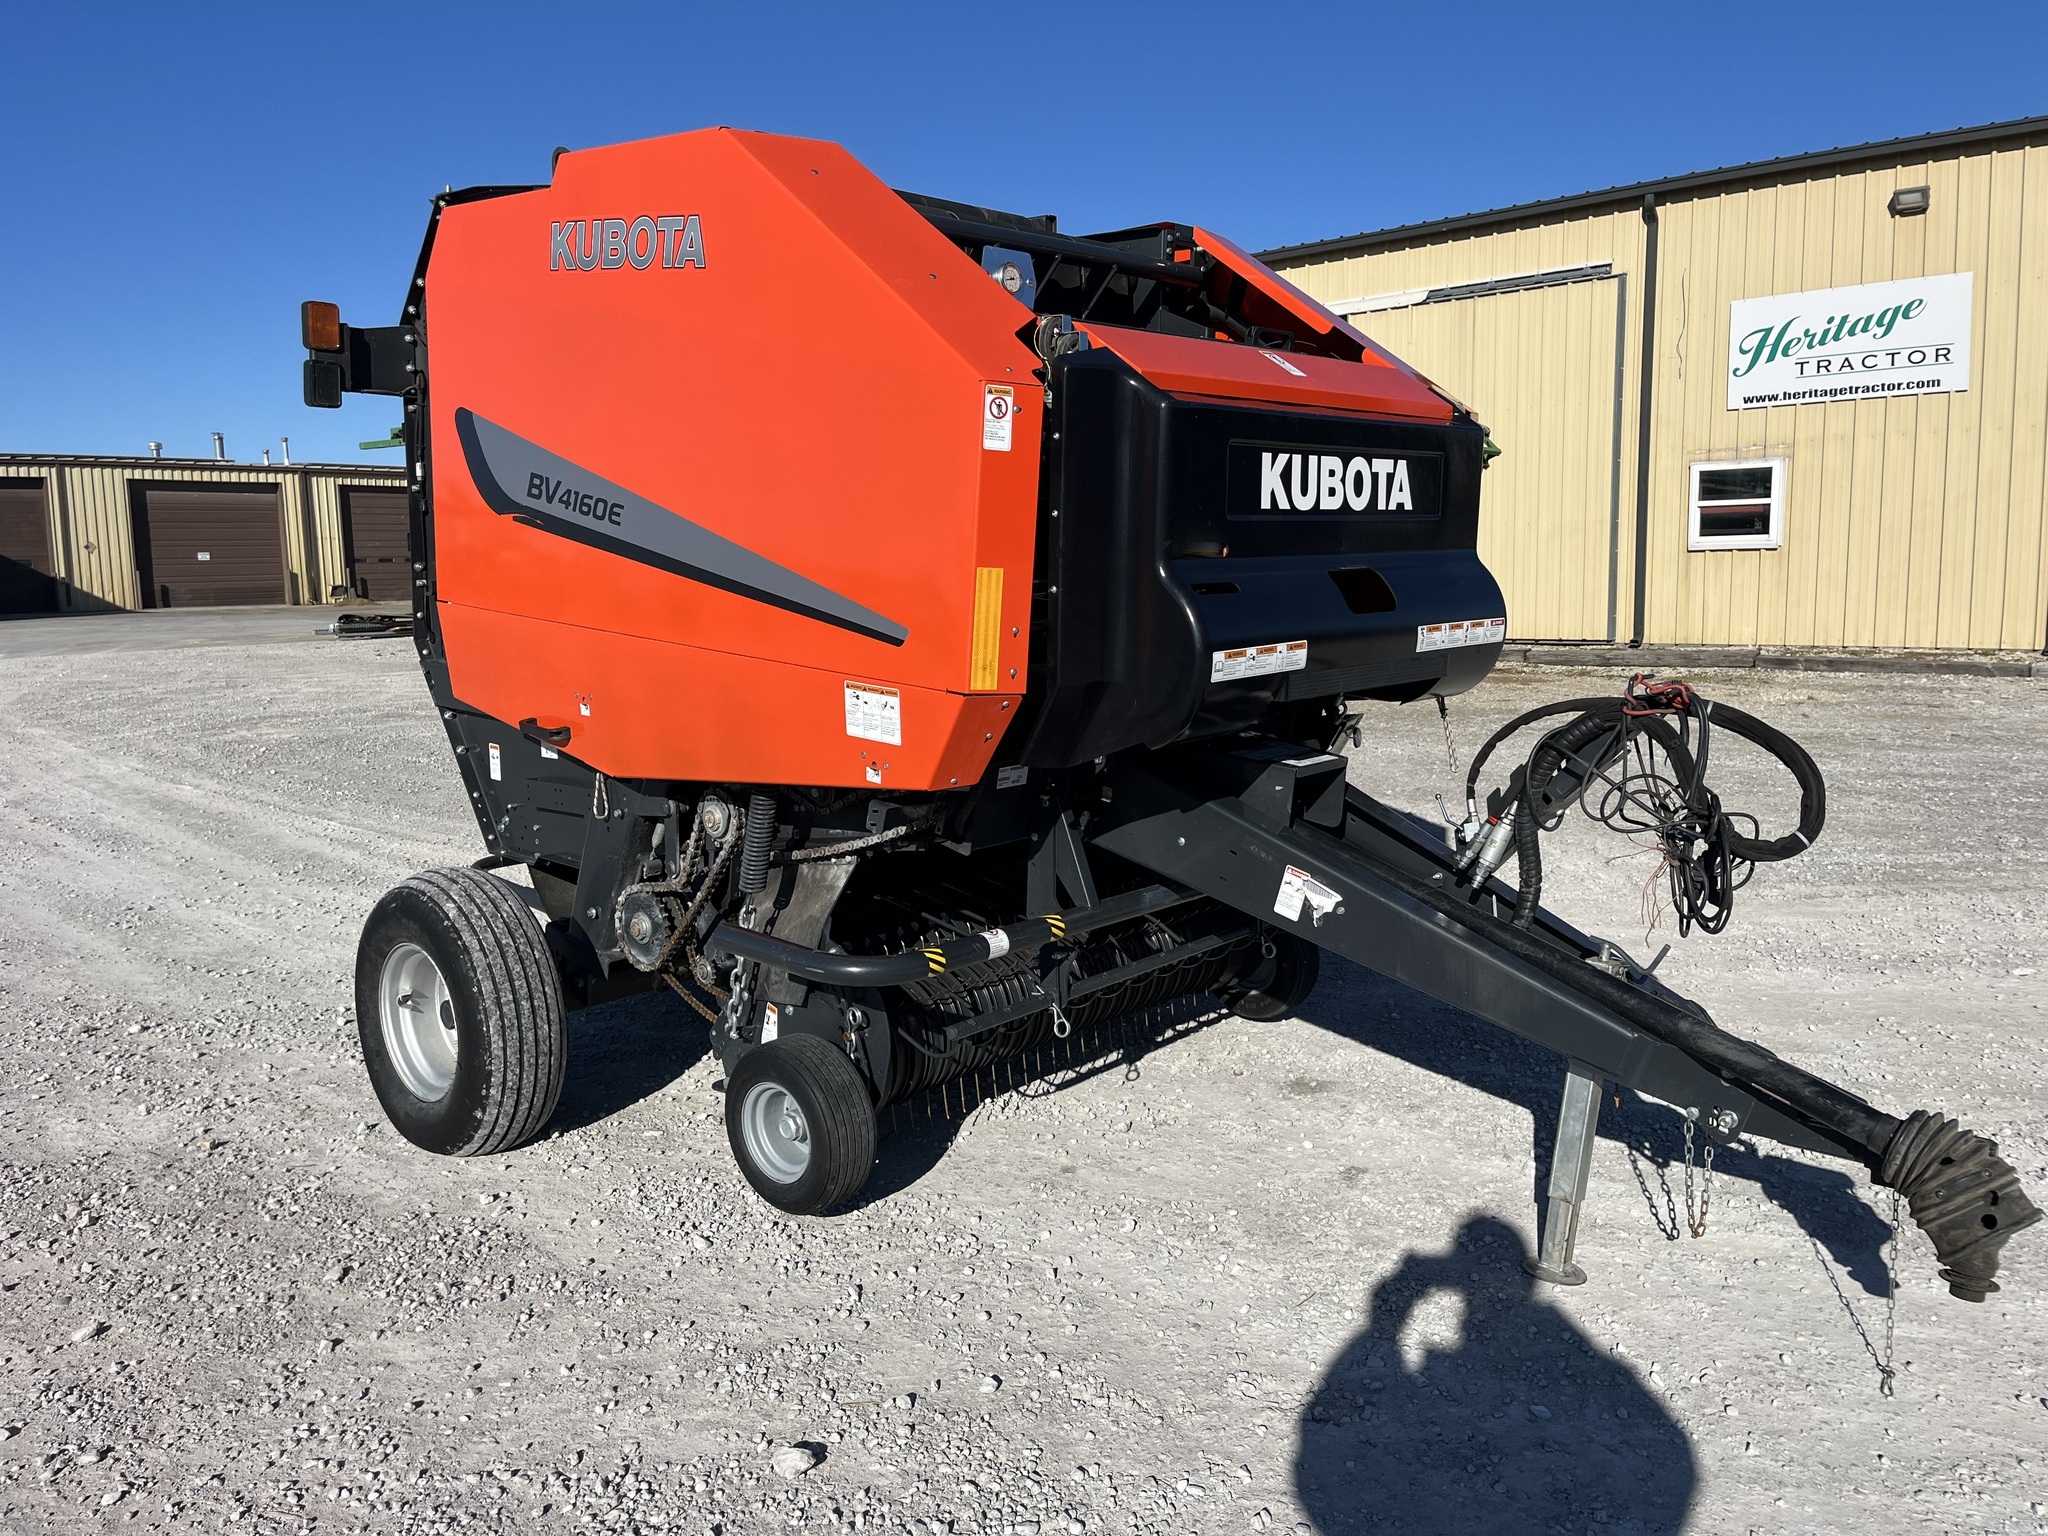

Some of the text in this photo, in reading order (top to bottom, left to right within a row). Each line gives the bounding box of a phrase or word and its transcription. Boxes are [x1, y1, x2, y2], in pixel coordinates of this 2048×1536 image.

[550, 214, 706, 272] KUBOTA
[1732, 298, 1928, 378] Heritage
[1795, 347, 1952, 376] TRACTOR
[1743, 378, 1942, 405] www.heritagetractor.com
[526, 471, 625, 527] BV4160E
[1260, 451, 1413, 512] KUBOTA
